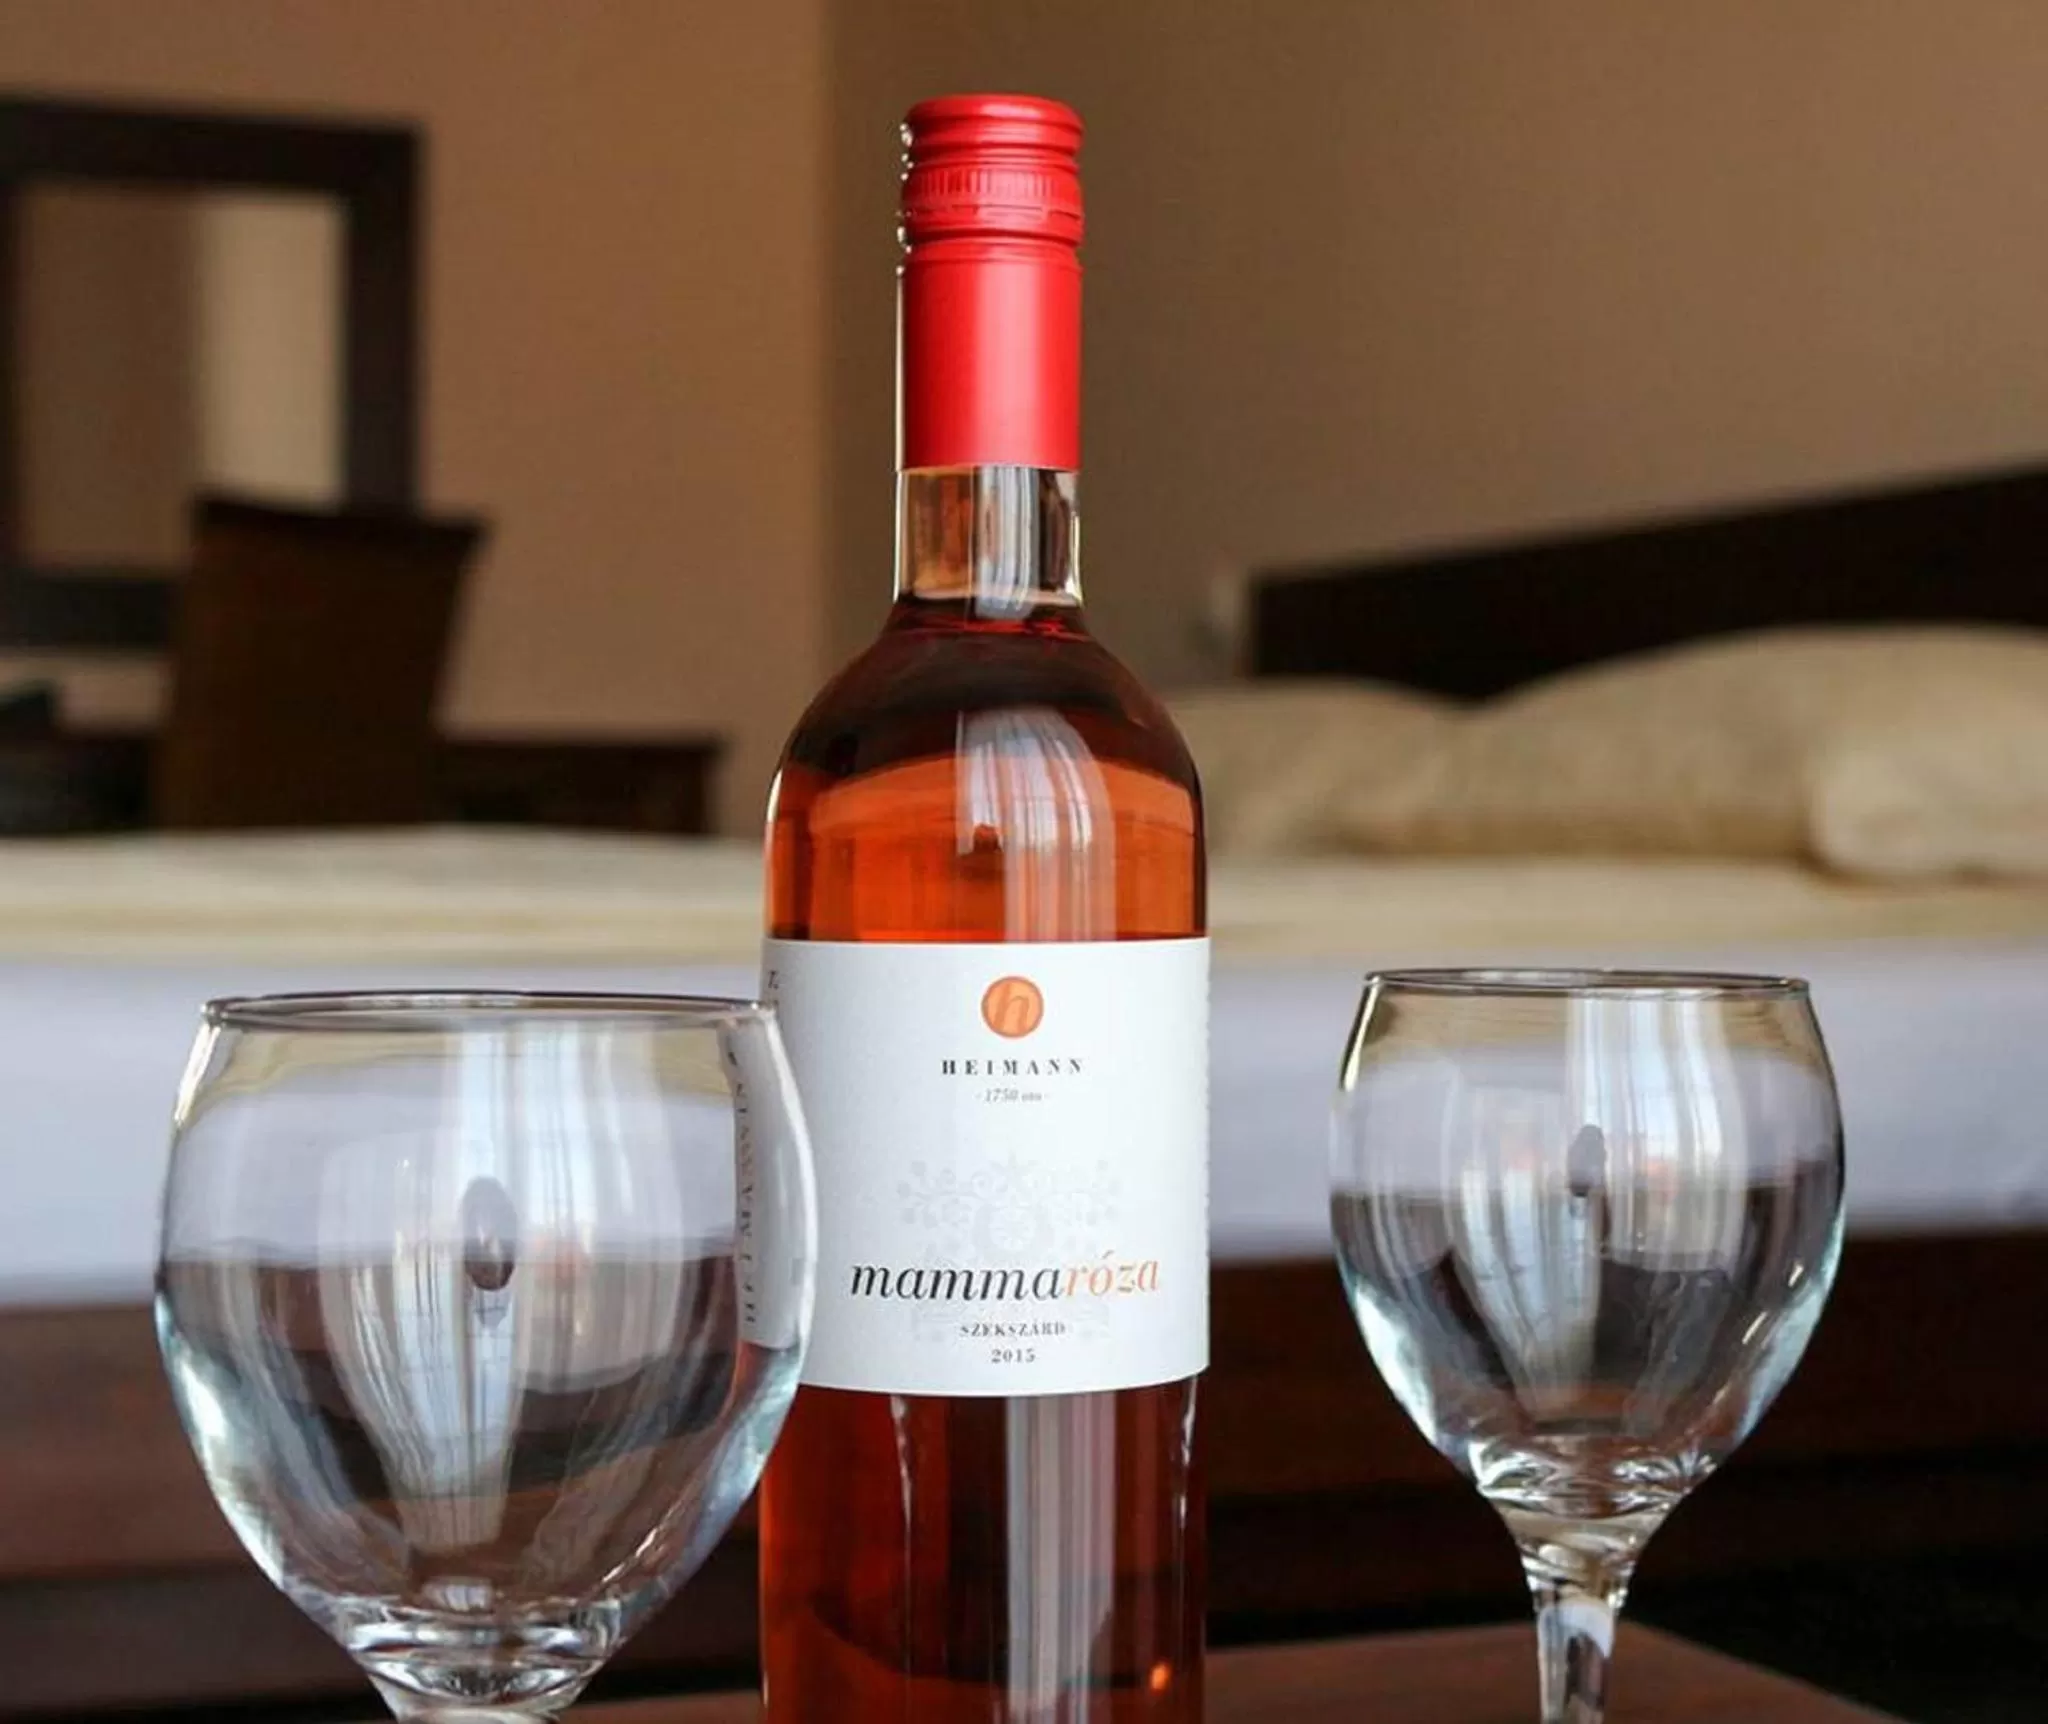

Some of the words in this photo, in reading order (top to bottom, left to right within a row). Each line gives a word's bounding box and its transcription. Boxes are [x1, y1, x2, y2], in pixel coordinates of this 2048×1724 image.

[941, 1059, 1084, 1076] HEIMANN
[984, 1087, 1019, 1102] 1750
[990, 1348, 1037, 1364] 2015
